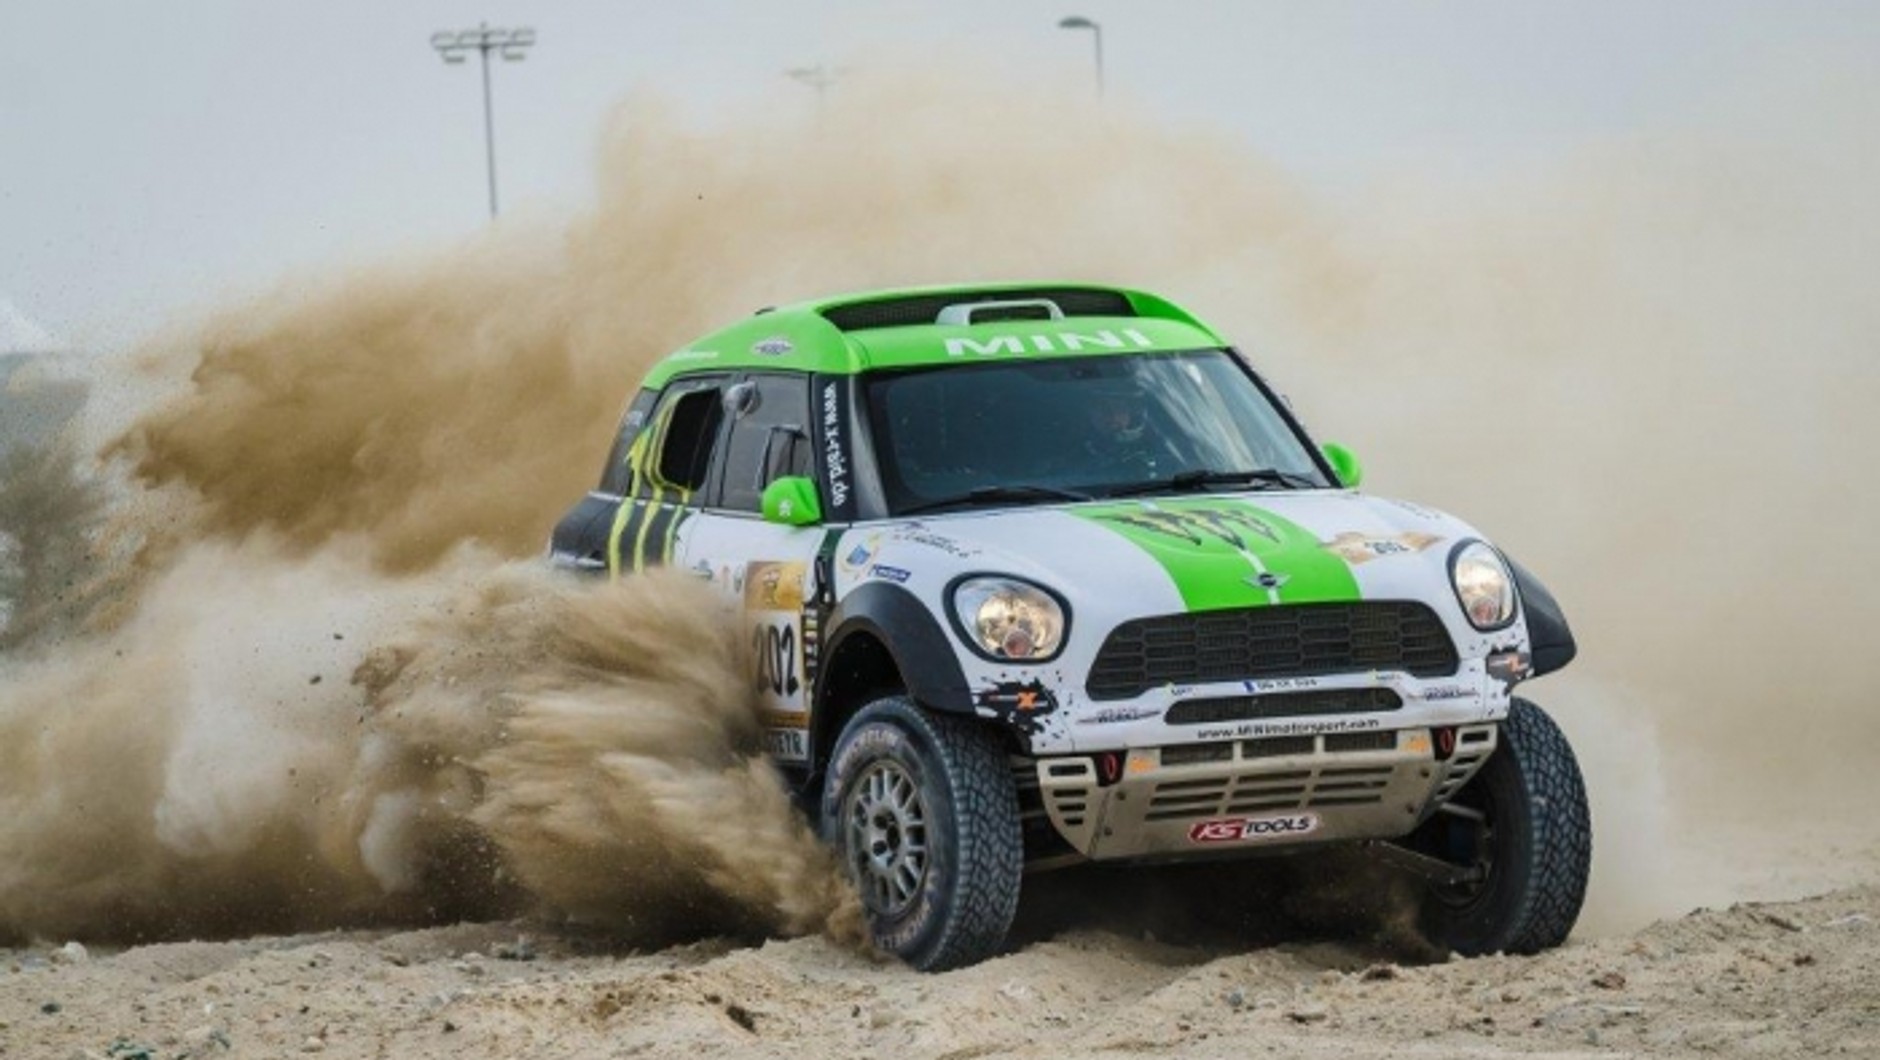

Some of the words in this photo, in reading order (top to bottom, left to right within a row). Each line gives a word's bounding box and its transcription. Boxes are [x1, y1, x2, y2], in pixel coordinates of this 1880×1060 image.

[944, 328, 1153, 357] MINI
[753, 622, 799, 697] 202
[1245, 817, 1310, 834] TOOLS
